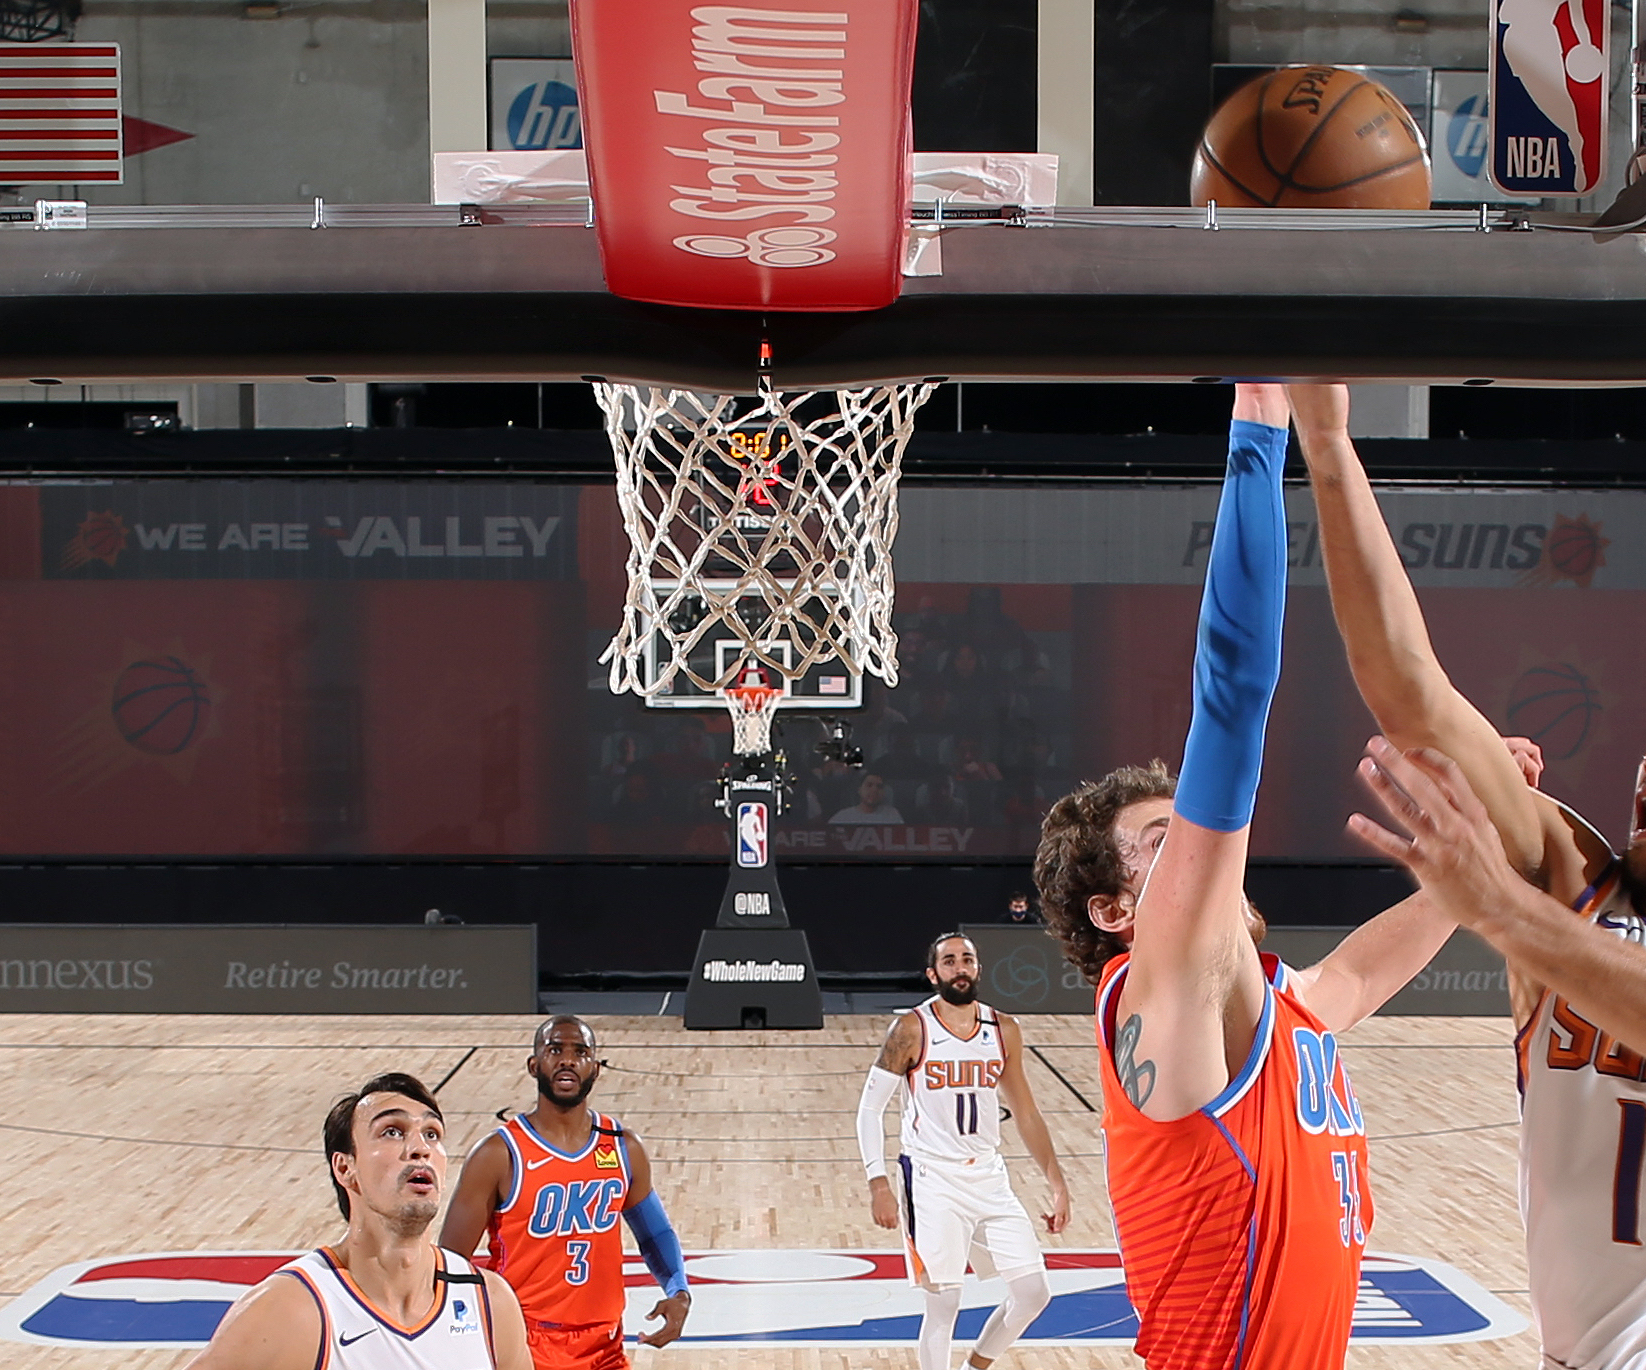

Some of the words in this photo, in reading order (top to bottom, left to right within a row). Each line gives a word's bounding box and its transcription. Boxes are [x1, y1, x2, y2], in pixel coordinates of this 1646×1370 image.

[515, 82, 580, 149] hp
[1507, 137, 1561, 179] NBA
[134, 523, 207, 551] WE
[218, 523, 310, 551] ARE
[325, 516, 561, 557] VALLEY
[1400, 523, 1548, 570] SUNS
[841, 827, 974, 852] VALLEY
[734, 892, 770, 916] @NBA
[225, 961, 322, 990] Retire
[331, 960, 469, 990] Smarter.
[702, 960, 805, 983] #WholeNewGame
[925, 1059, 1003, 1091] SUNS
[954, 1092, 979, 1137] 11
[527, 1178, 624, 1239] OKC
[565, 1240, 591, 1286] 3
[449, 1323, 479, 1334] PayPal
